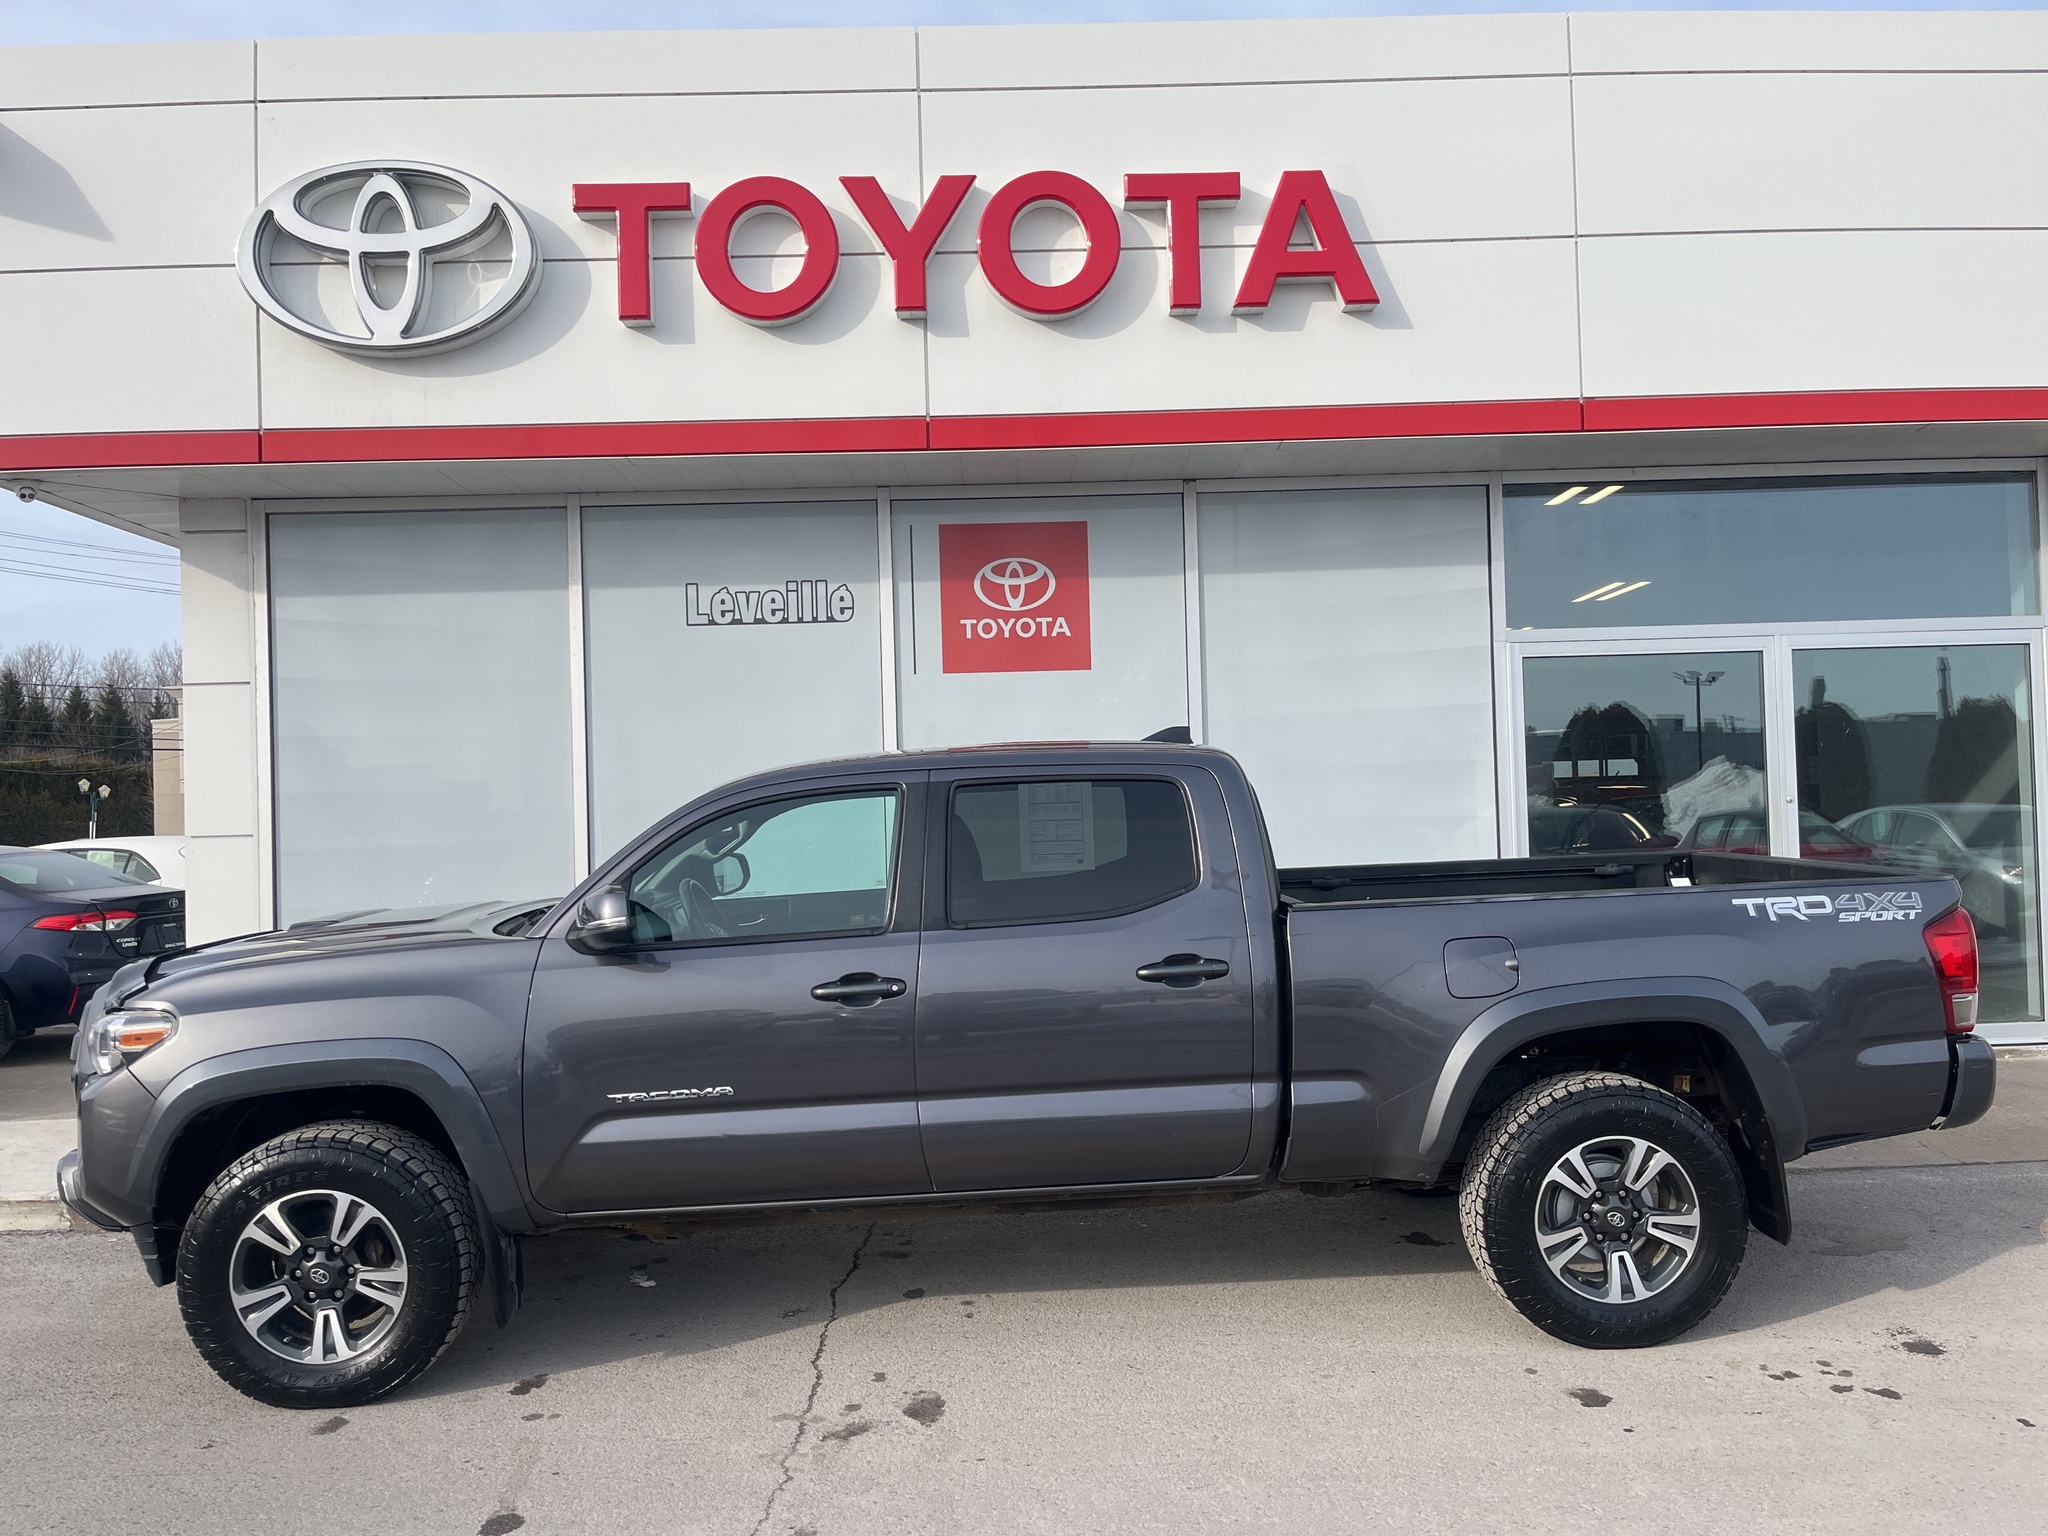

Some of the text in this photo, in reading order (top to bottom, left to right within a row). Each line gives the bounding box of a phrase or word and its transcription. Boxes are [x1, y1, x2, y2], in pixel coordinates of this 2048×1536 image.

[572, 170, 1380, 327] TOYOTA
[685, 579, 855, 627] Léveillé
[960, 616, 1072, 640] TOYOTA
[1732, 895, 1835, 922] TRD
[1838, 909, 1922, 923] SPORT
[606, 1085, 734, 1103] TACOMA
